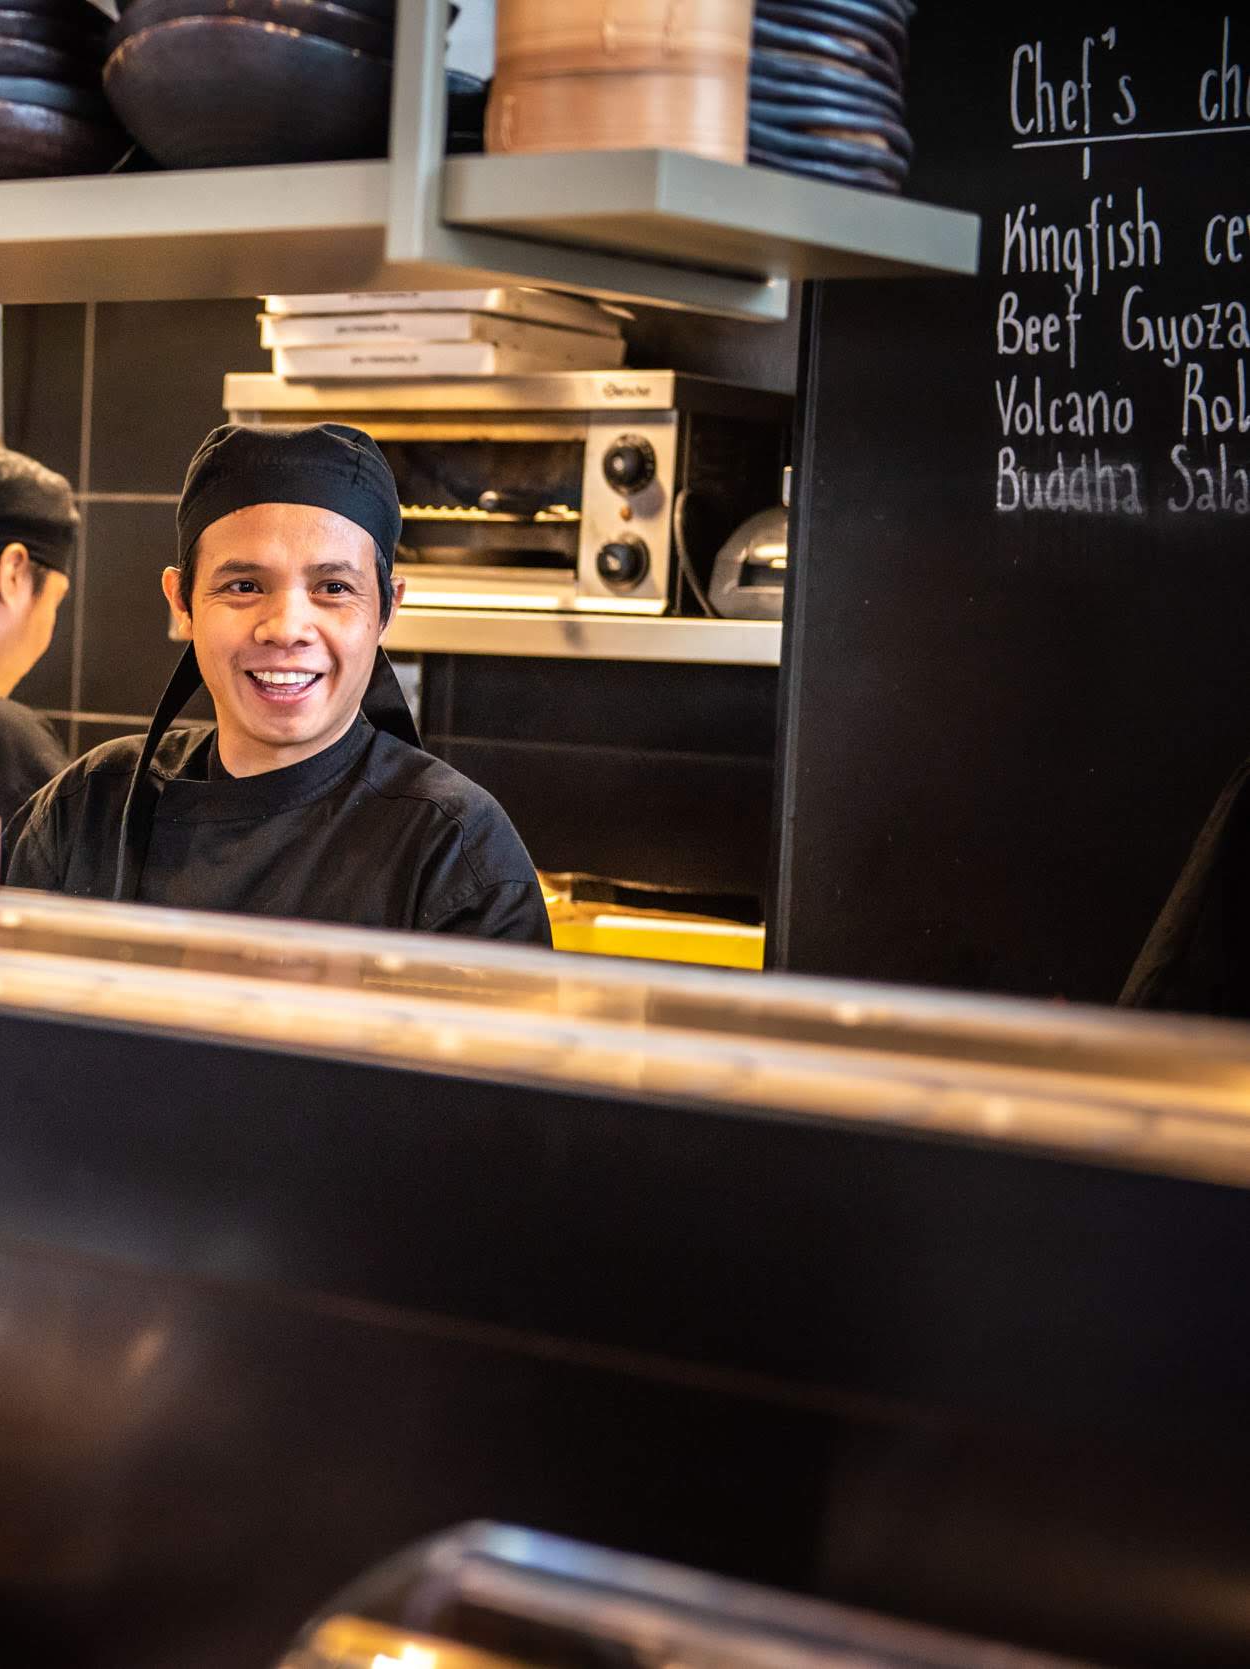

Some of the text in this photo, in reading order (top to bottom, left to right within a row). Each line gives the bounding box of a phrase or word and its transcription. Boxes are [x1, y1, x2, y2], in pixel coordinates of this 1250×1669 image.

[1010, 15, 1250, 180] Chef's ch
[1001, 186, 1250, 296] Kingfish ce
[997, 285, 1250, 369] Beef Gyoza
[995, 374, 1134, 436] Volcano
[996, 446, 1143, 514] Buddha
